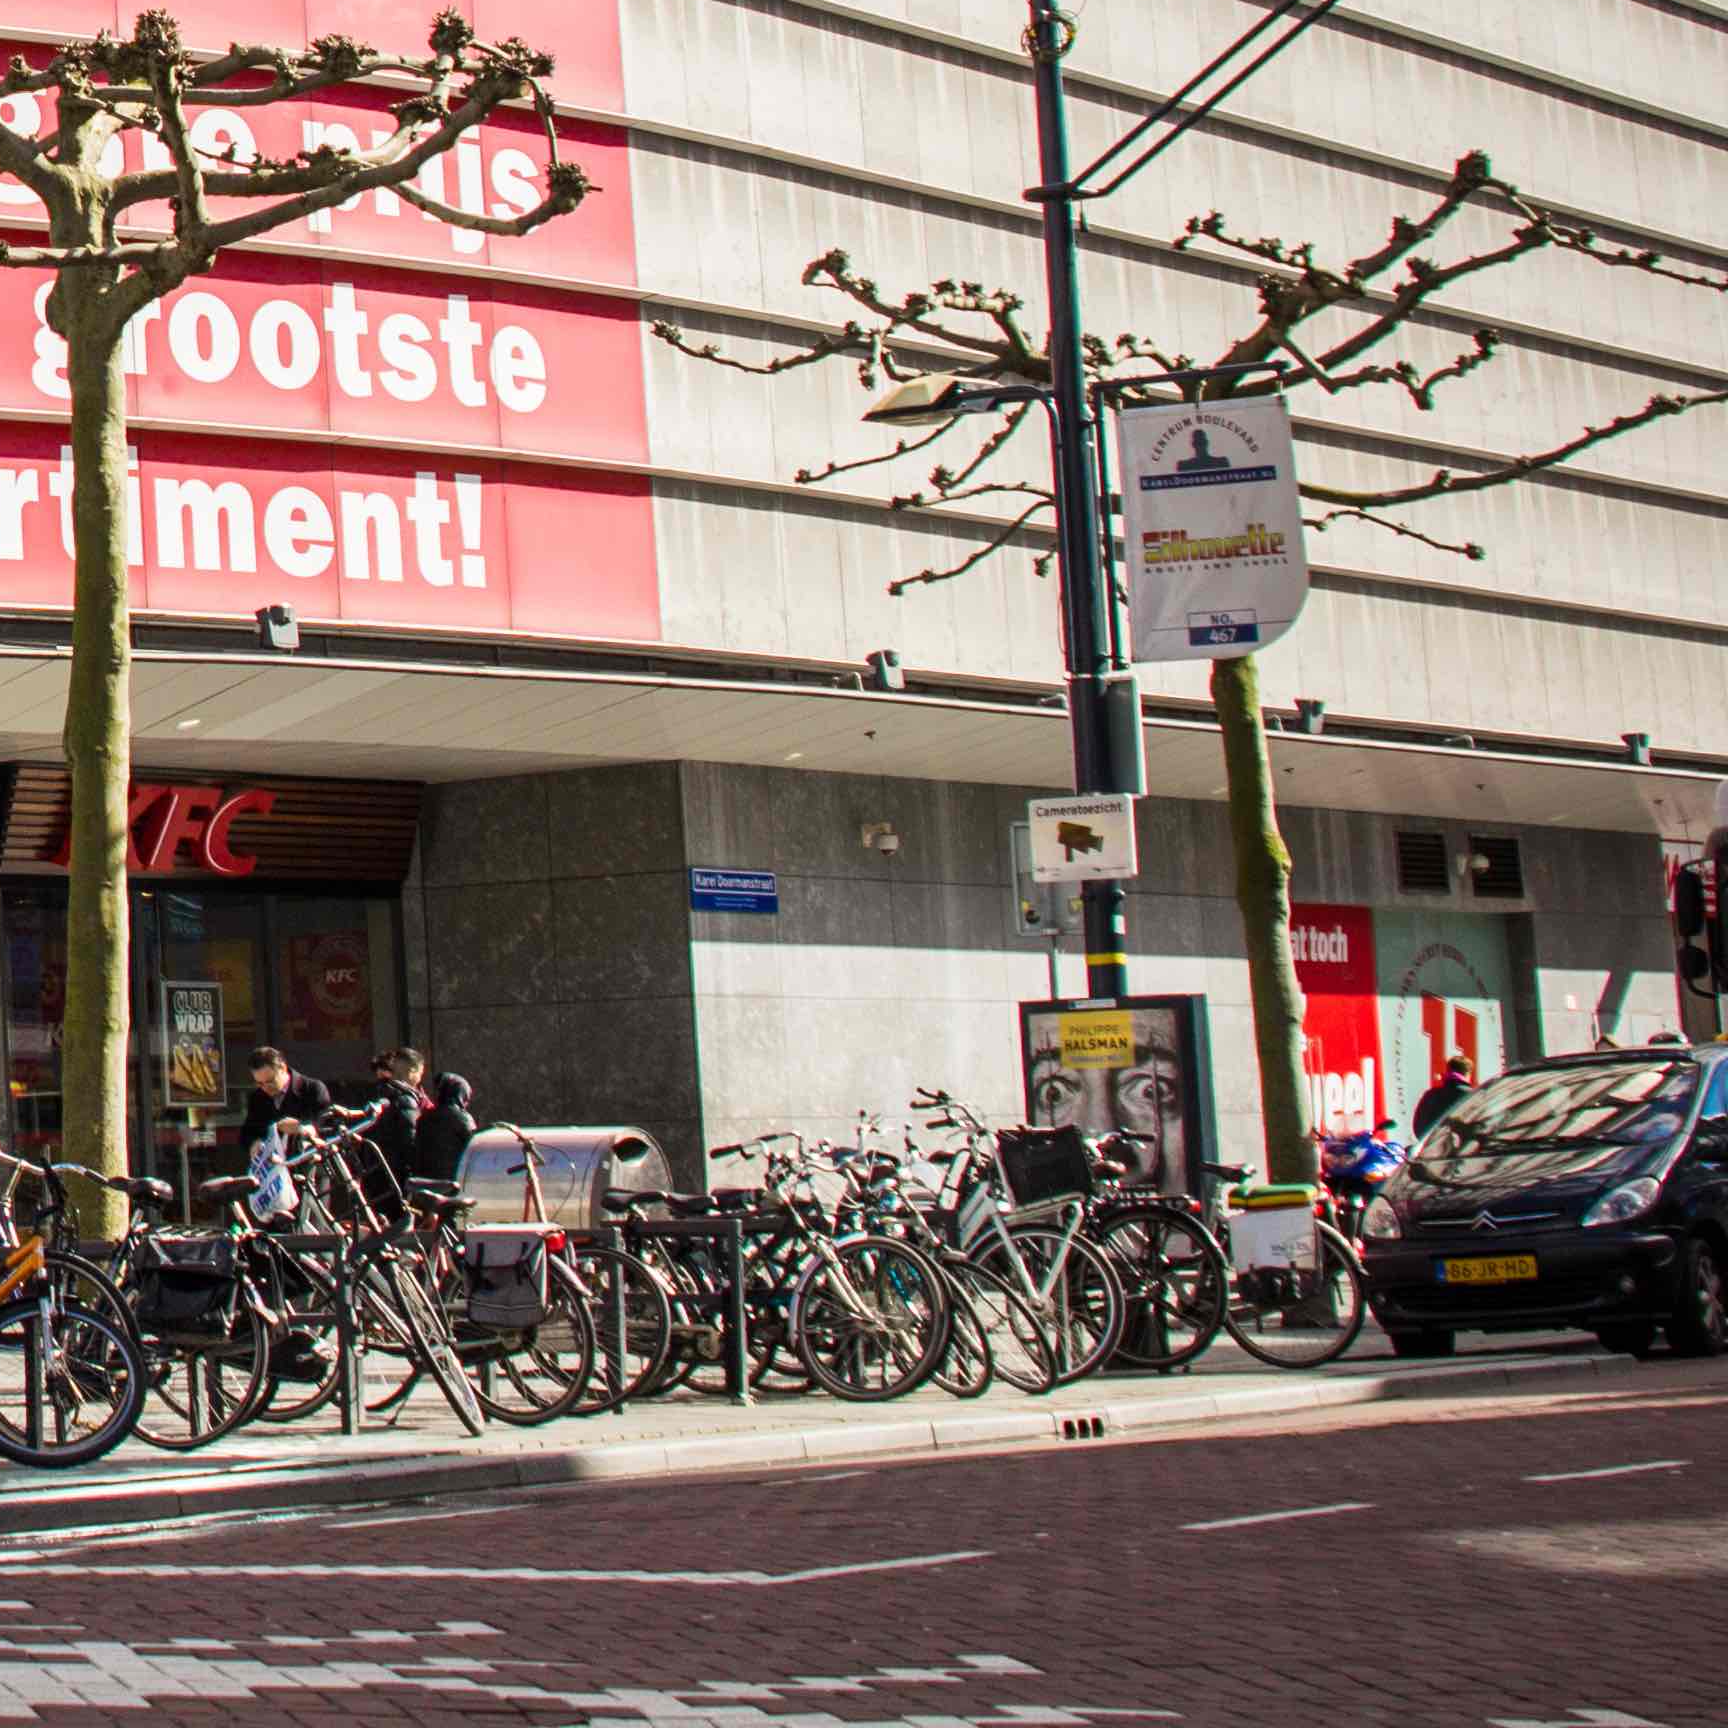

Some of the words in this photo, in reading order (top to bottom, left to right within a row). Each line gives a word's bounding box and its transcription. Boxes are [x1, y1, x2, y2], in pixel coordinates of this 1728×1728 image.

[1152, 417, 1192, 462] CENTRUM
[1195, 414, 1259, 454] BOULEVARD
[1209, 628, 1237, 643] 467
[1035, 802, 1123, 817] Cameratoezicht
[1310, 925, 1348, 962] toch
[174, 991, 212, 1012] CLUB
[176, 1015, 214, 1033] WRAP
[1064, 1037, 1129, 1052] HALSMAN
